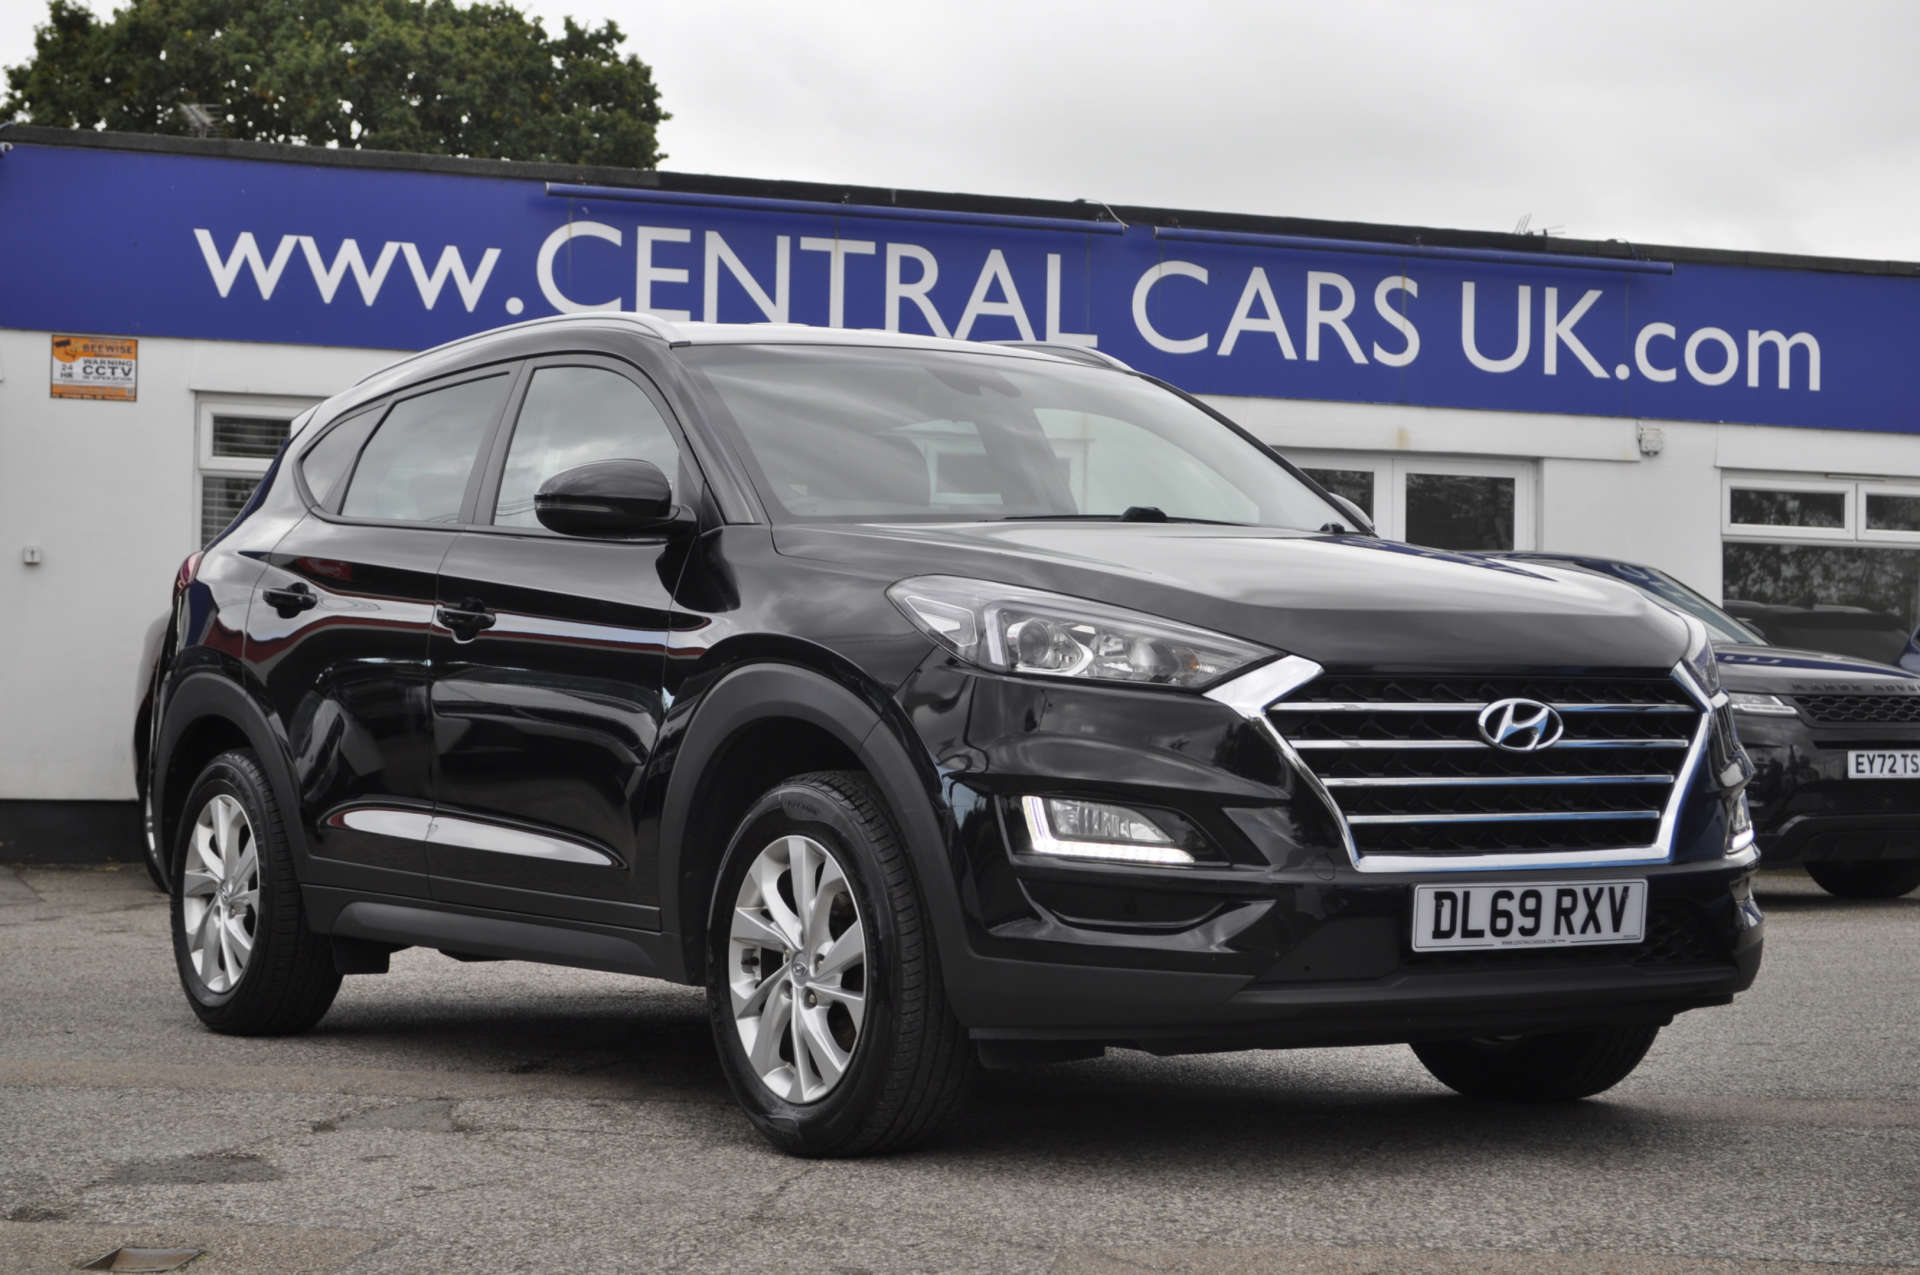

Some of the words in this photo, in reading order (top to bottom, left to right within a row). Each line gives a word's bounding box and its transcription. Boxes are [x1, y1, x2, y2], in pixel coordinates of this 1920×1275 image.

[1132, 261, 1421, 367] CARS
[1461, 281, 1821, 391] UK.com
[82, 343, 133, 354] BEEWISE
[82, 365, 132, 376] CCTV
[83, 359, 133, 367] WARNING
[1855, 754, 1897, 774] EY72
[1901, 754, 1920, 774] TS
[1431, 889, 1543, 940] DL69
[1553, 886, 1630, 936] RXV
